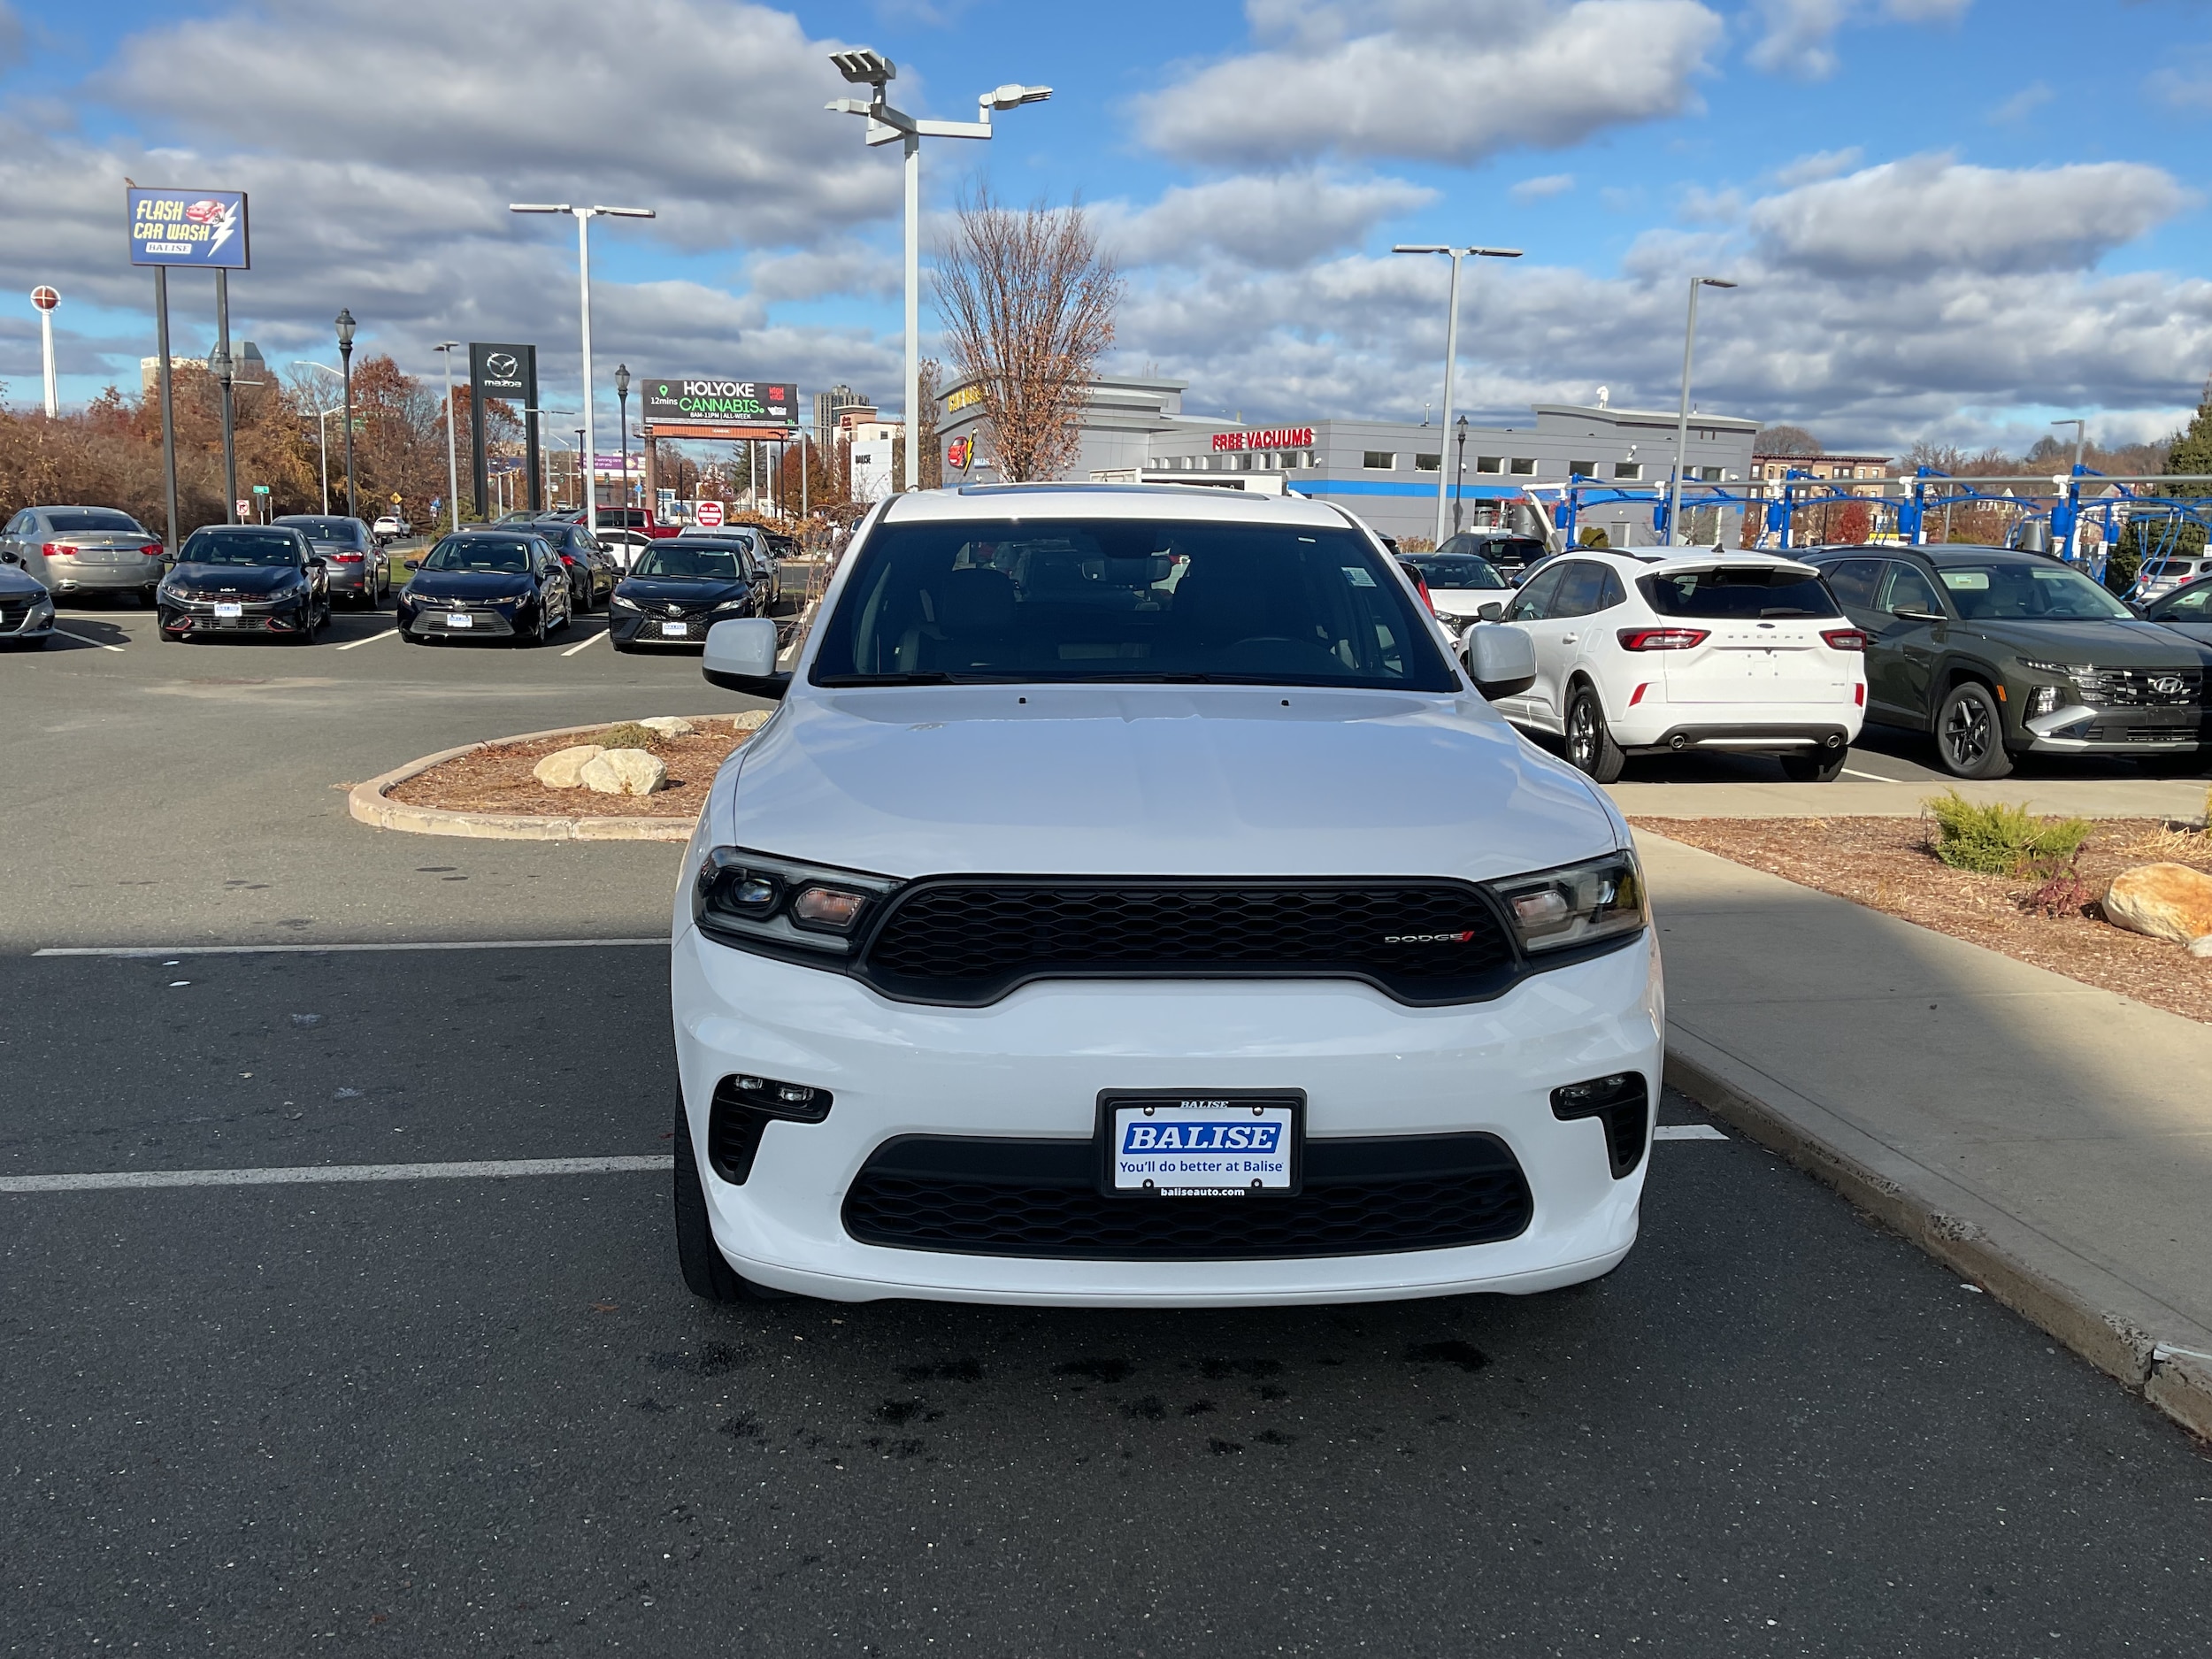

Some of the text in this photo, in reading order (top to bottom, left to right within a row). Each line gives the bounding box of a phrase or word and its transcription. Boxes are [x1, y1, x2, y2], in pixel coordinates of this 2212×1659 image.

[136, 200, 184, 220] FLASH
[134, 223, 211, 241] CAR WASH
[684, 380, 755, 397] HOLYOKE
[1213, 427, 1314, 450] FREE VACUUMS
[1385, 933, 1464, 943] DODGE
[1128, 1126, 1276, 1149] BALISE
[1119, 1161, 1283, 1172] You'll do better at Balise
[1160, 1187, 1245, 1196] baliseauto.com
